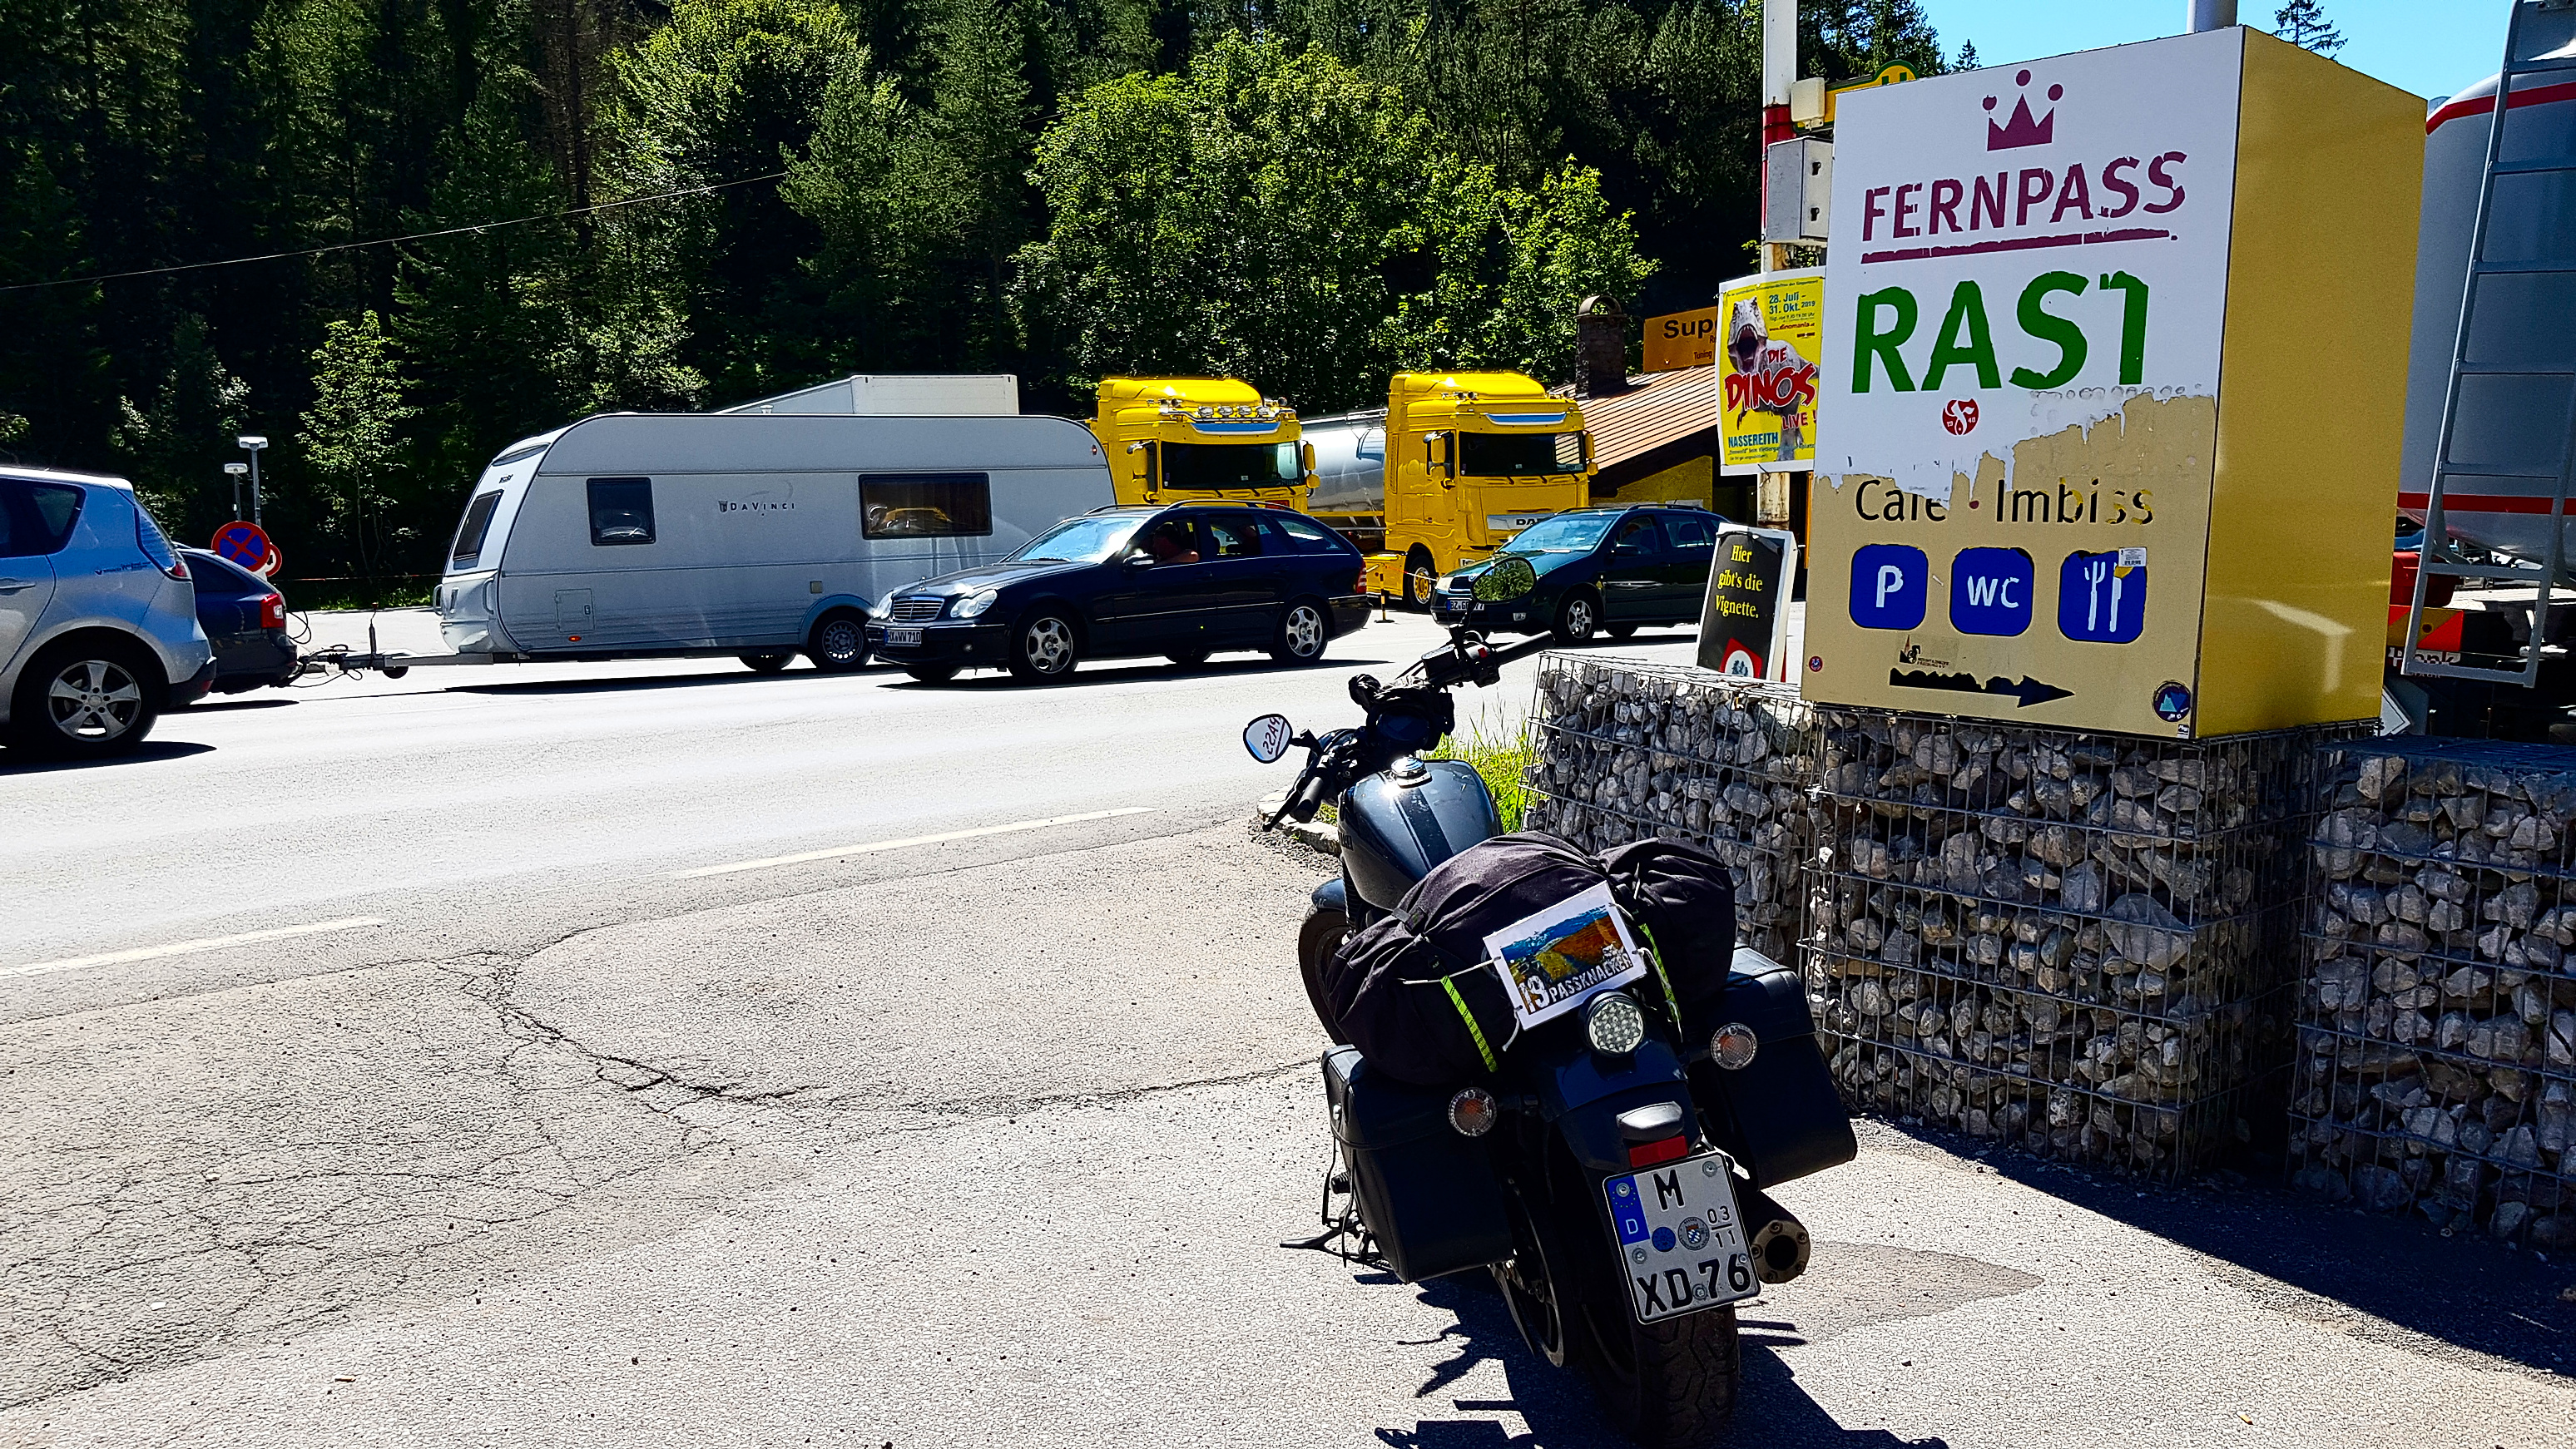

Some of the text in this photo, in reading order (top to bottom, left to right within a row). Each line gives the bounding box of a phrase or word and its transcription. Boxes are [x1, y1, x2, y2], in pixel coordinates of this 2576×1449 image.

[1862, 151, 2187, 241] FERNPASS
[1769, 294, 1781, 304] 28.
[1783, 292, 1799, 303] Juli
[1769, 305, 1781, 314] 31.
[1783, 303, 1800, 313] Okt.
[1663, 319, 1717, 339] Sup
[1851, 270, 2149, 393] RAST
[1693, 350, 1712, 359] Tuning
[1767, 347, 1787, 363] DIE
[1724, 362, 1816, 413] DINOS
[1728, 432, 1779, 448] NASSEREITH
[1996, 477, 2153, 525] Imbiss
[1731, 545, 1752, 563] Hier
[1745, 573, 1763, 591] die
[1875, 565, 1904, 608] P
[1967, 576, 2019, 608] WC
[1715, 595, 1759, 618] Vignette.
[1518, 952, 1633, 1013] 19 PASSKNACKER
[1652, 1168, 1685, 1211] M
[1625, 1205, 1730, 1235] D 03
[1716, 1229, 1736, 1249] 11
[1637, 1253, 1751, 1317] XD 76
